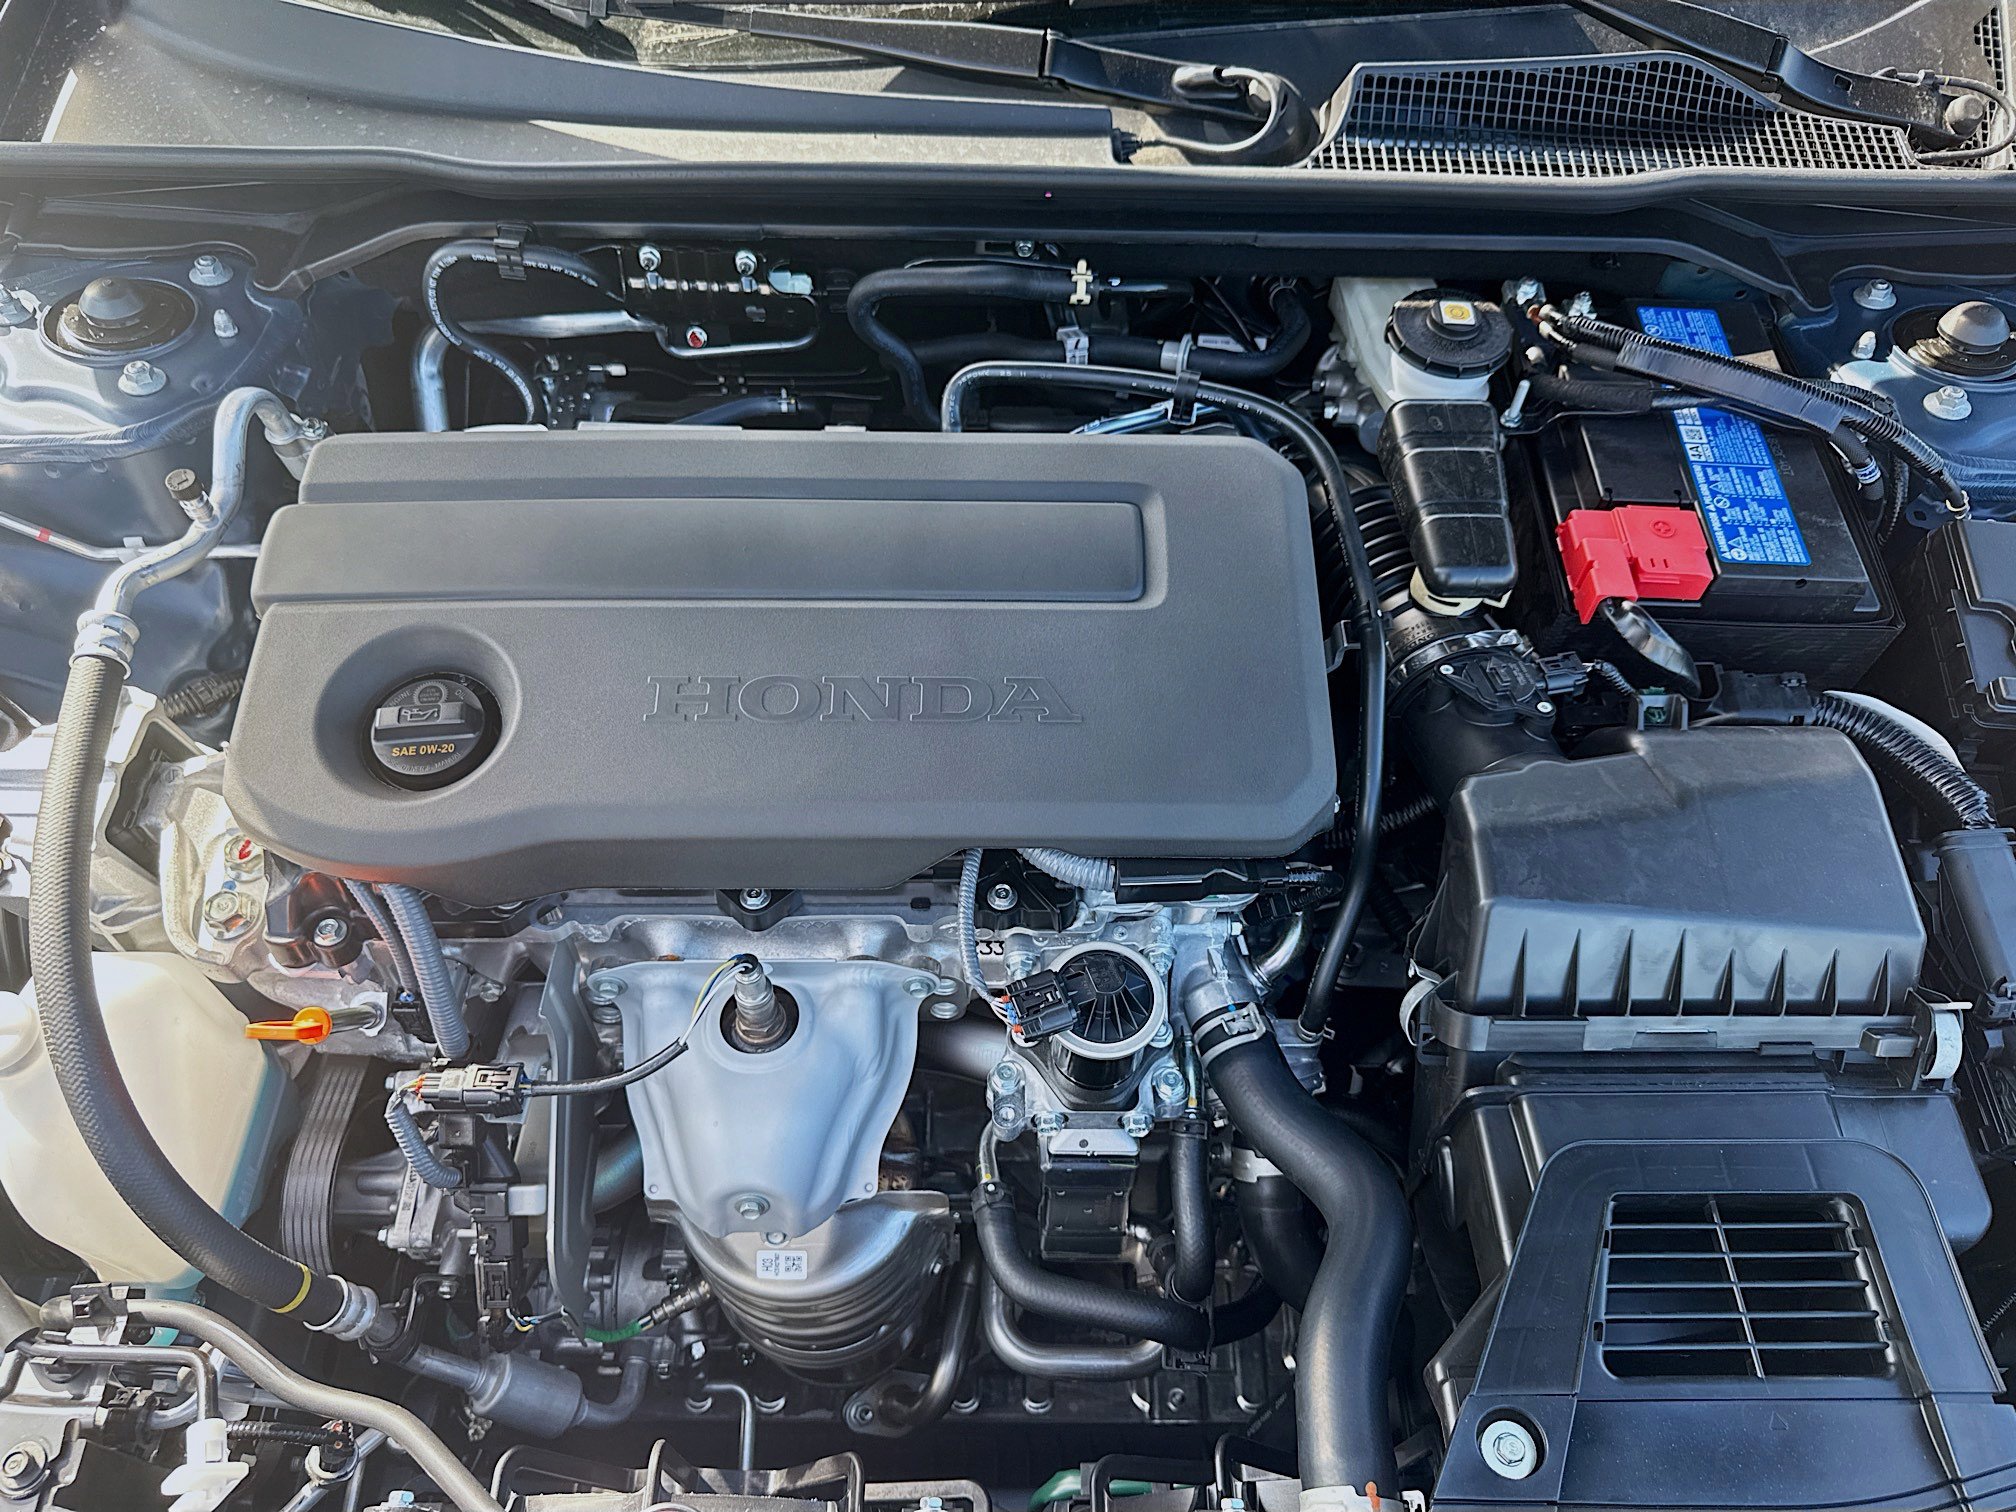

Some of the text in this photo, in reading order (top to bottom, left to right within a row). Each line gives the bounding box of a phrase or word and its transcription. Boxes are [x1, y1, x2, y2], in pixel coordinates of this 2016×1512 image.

[643, 674, 1083, 723] HONDA
[392, 744, 454, 757] SAE 0W-20
